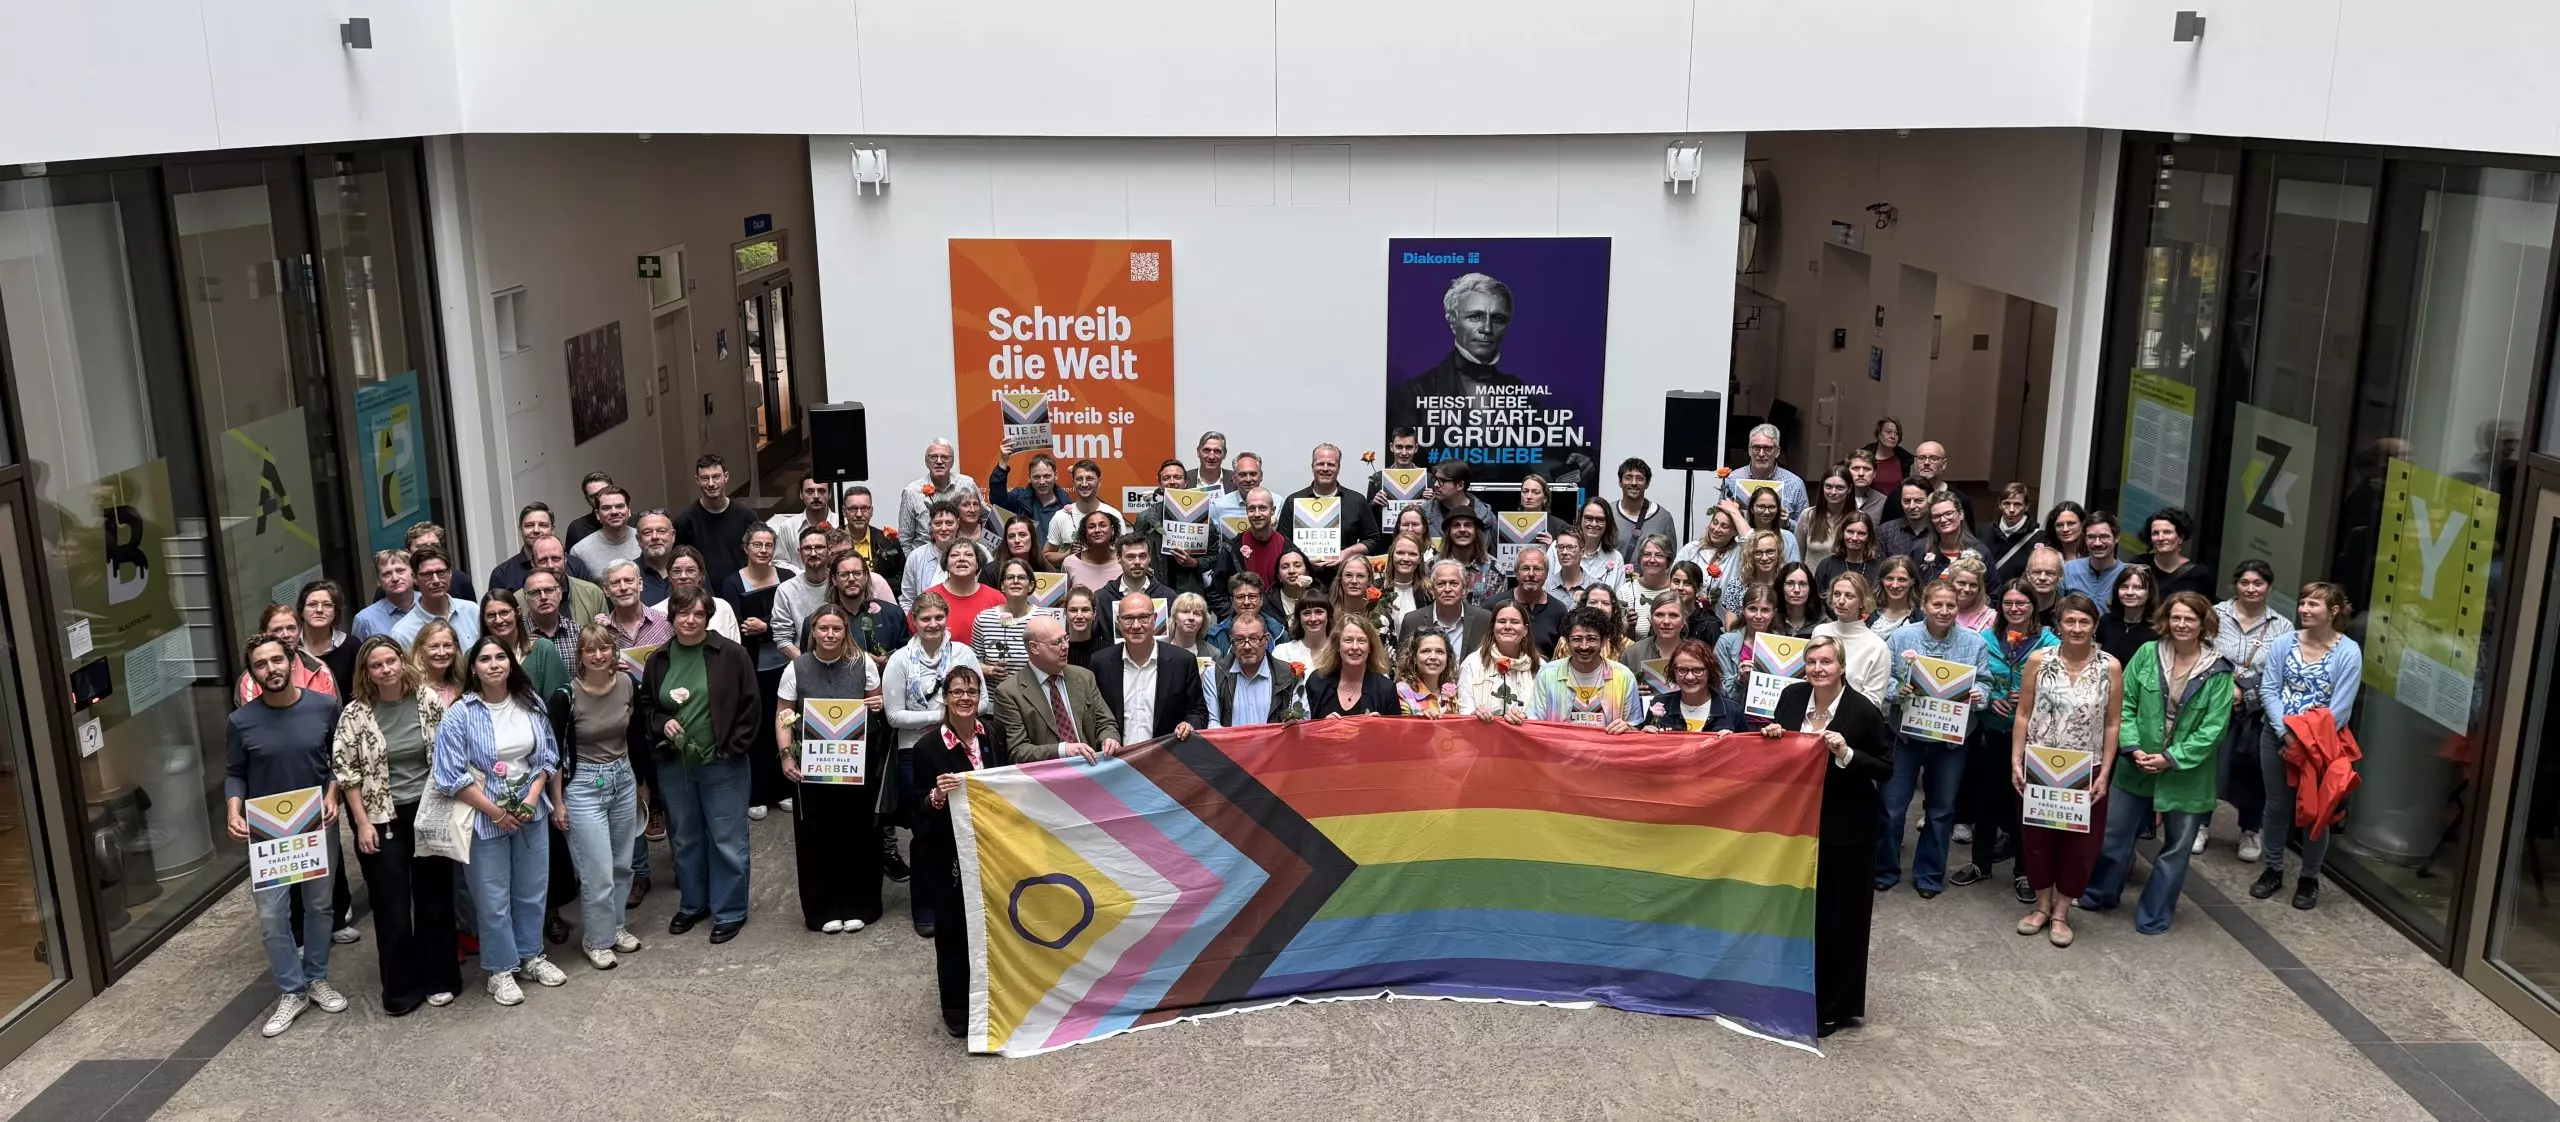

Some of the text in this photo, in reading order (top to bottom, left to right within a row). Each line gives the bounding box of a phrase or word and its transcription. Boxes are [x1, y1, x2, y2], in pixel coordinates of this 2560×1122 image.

[1403, 252, 1465, 264] Diakonie
[988, 306, 1132, 342] Schreib
[989, 345, 1139, 380] die Welt
[1047, 384, 1076, 402] ab.
[1475, 385, 1552, 395] MANCHMAL
[1416, 396, 1532, 410] HEISST LIEBE,
[1108, 406, 1135, 425] sie
[1427, 409, 1573, 426] EIN START-UP
[1008, 425, 1047, 436] LIEBE
[1414, 426, 1592, 448] U GRÜNDEN.
[1016, 438, 1049, 447] ARBEN
[1052, 427, 1124, 459] um!
[1428, 447, 1544, 464] #AUSLIEBE
[2246, 434, 2293, 528] Z
[1128, 491, 1159, 503] Brt
[1167, 522, 1204, 535] LIEBE
[1297, 530, 1337, 540] LIEBE
[1166, 540, 1203, 548] FARBEN
[2411, 494, 2469, 601] Y
[103, 505, 149, 605] B
[1753, 696, 1776, 707] FAR
[1911, 697, 1963, 716] LIEBE
[1570, 713, 1602, 722] LIEBE
[1908, 716, 1960, 733] FARBEN
[808, 743, 859, 755] LIEBE
[807, 764, 858, 774] FARBEN
[2030, 787, 2084, 804] LIEBE
[2029, 807, 2083, 822] FARBEN
[257, 835, 319, 858] LIEBE
[268, 852, 310, 865] TRÄGT ALLE
[260, 857, 320, 879] FARBEN
